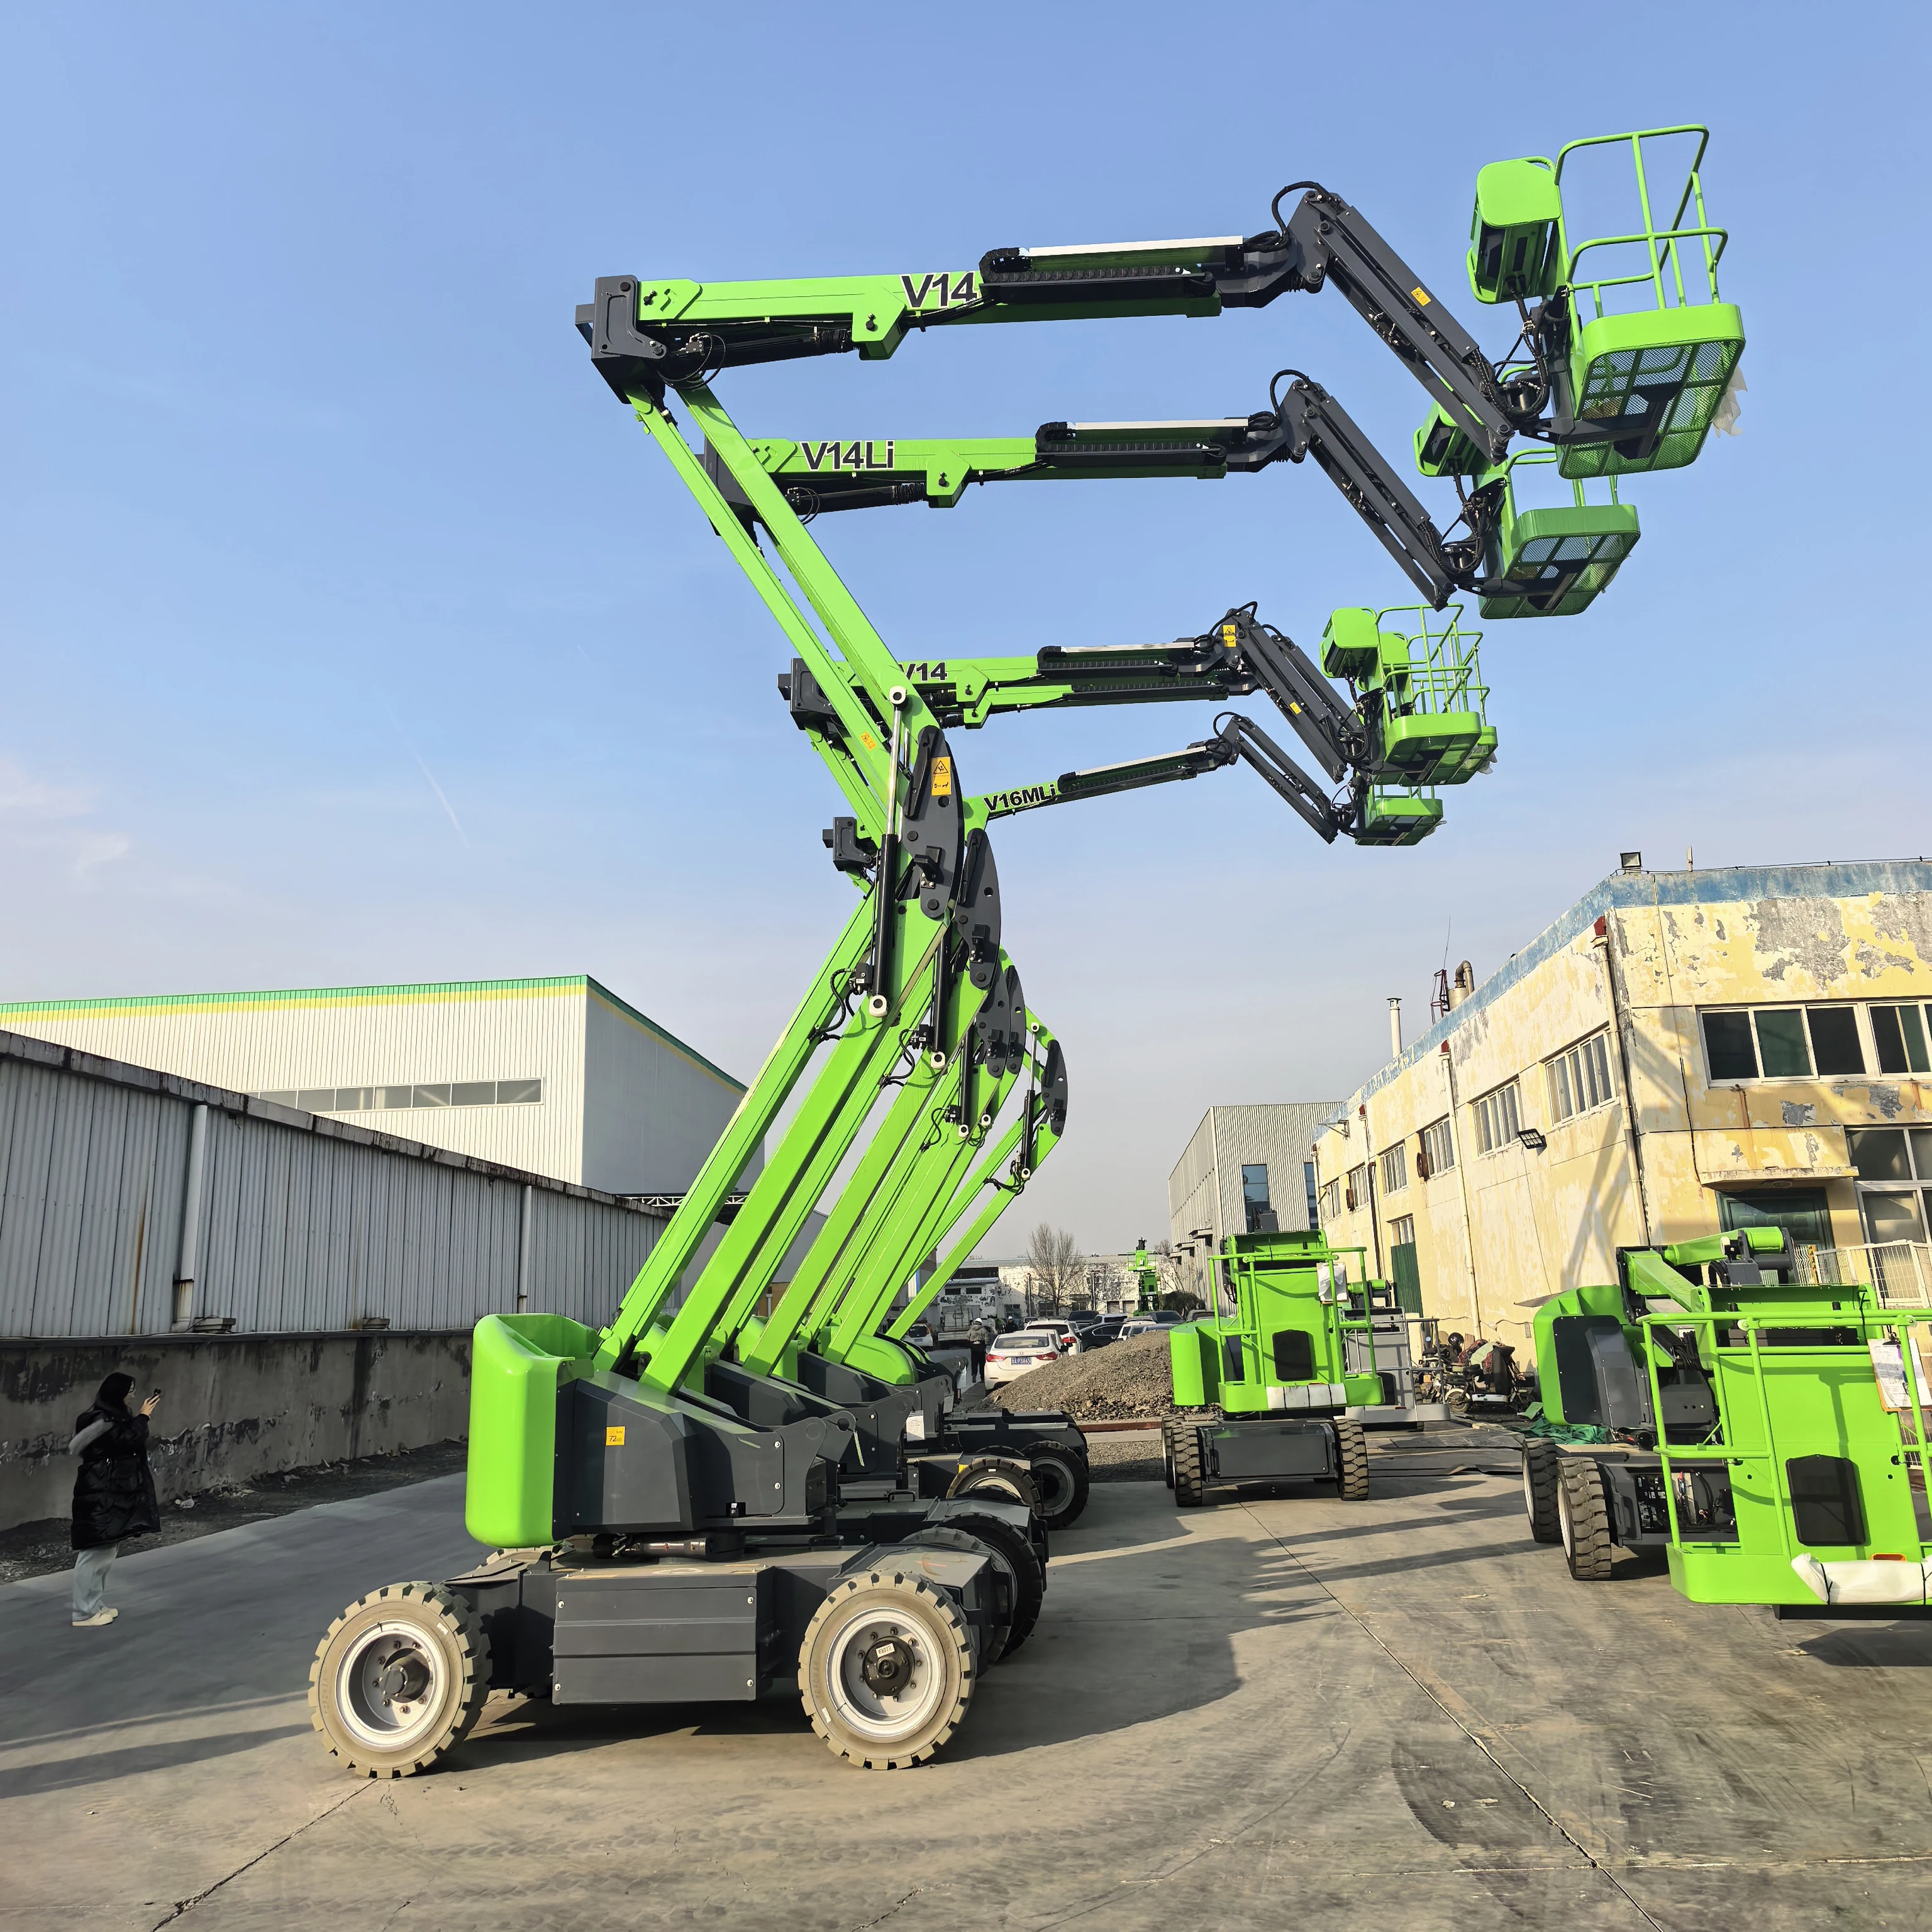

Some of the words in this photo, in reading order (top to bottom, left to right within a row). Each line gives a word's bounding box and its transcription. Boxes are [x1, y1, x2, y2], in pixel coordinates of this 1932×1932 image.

[900, 271, 979, 308] V14
[800, 440, 894, 471] V14Li
[983, 784, 1057, 812] V16MLi
